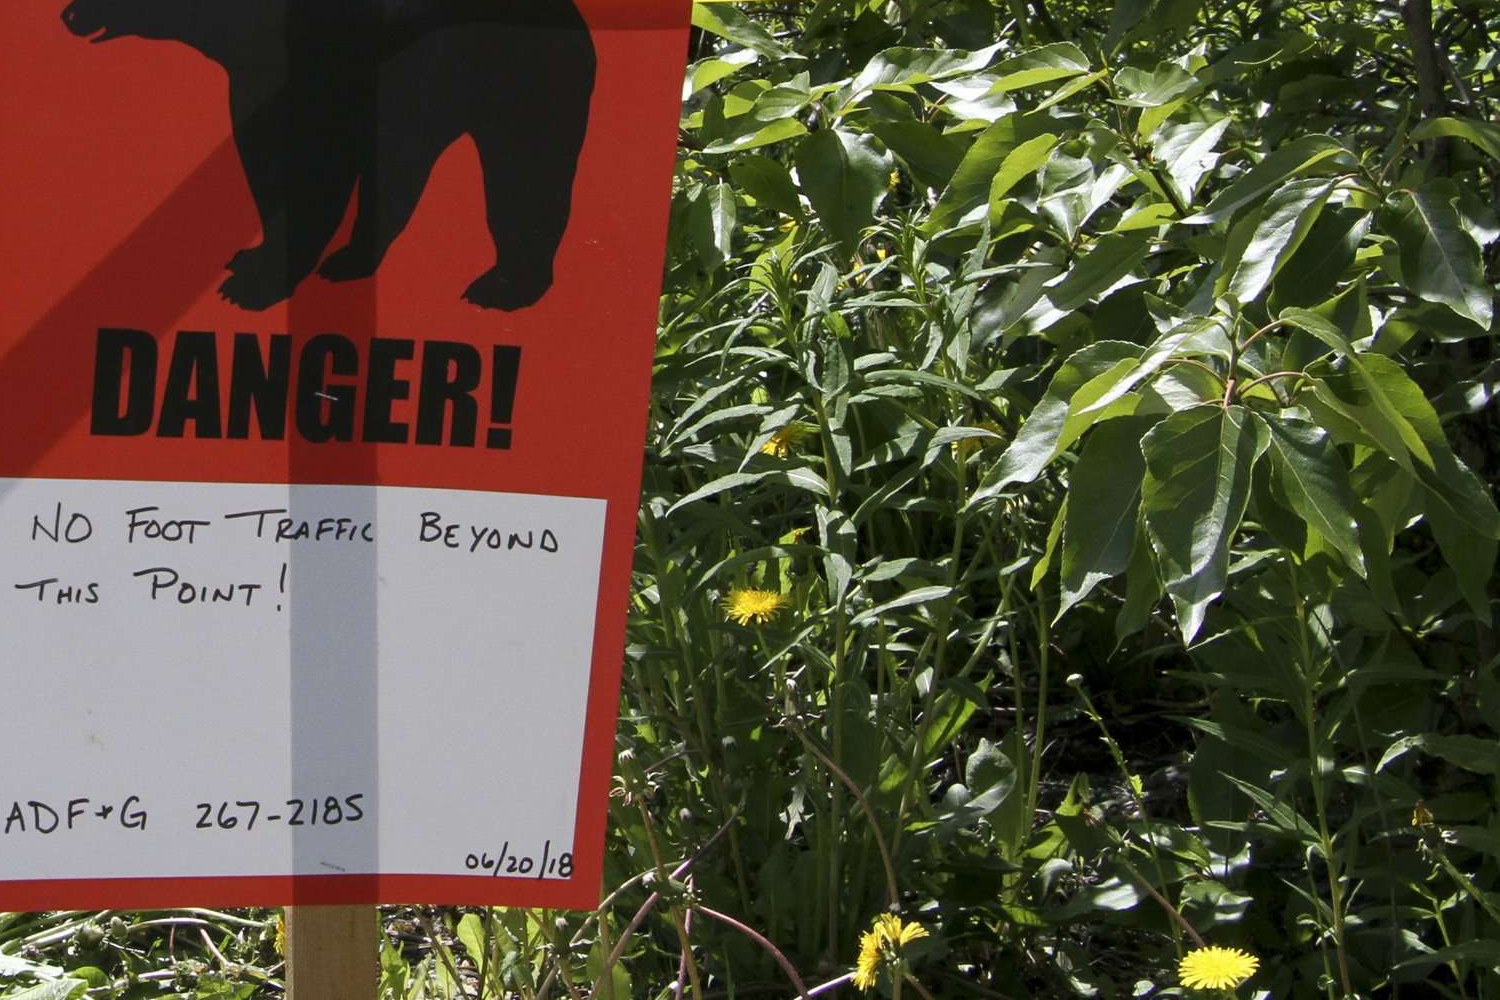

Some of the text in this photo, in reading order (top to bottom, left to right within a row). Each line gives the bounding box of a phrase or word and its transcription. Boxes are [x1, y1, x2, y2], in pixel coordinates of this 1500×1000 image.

[90, 328, 522, 450] DANGER!
[31, 502, 559, 553] NO FOOT TRAFFIC BEYOND
[14, 578, 100, 605] THIS
[195, 793, 364, 831] 267-2185
[464, 839, 574, 879] 06/20/18
